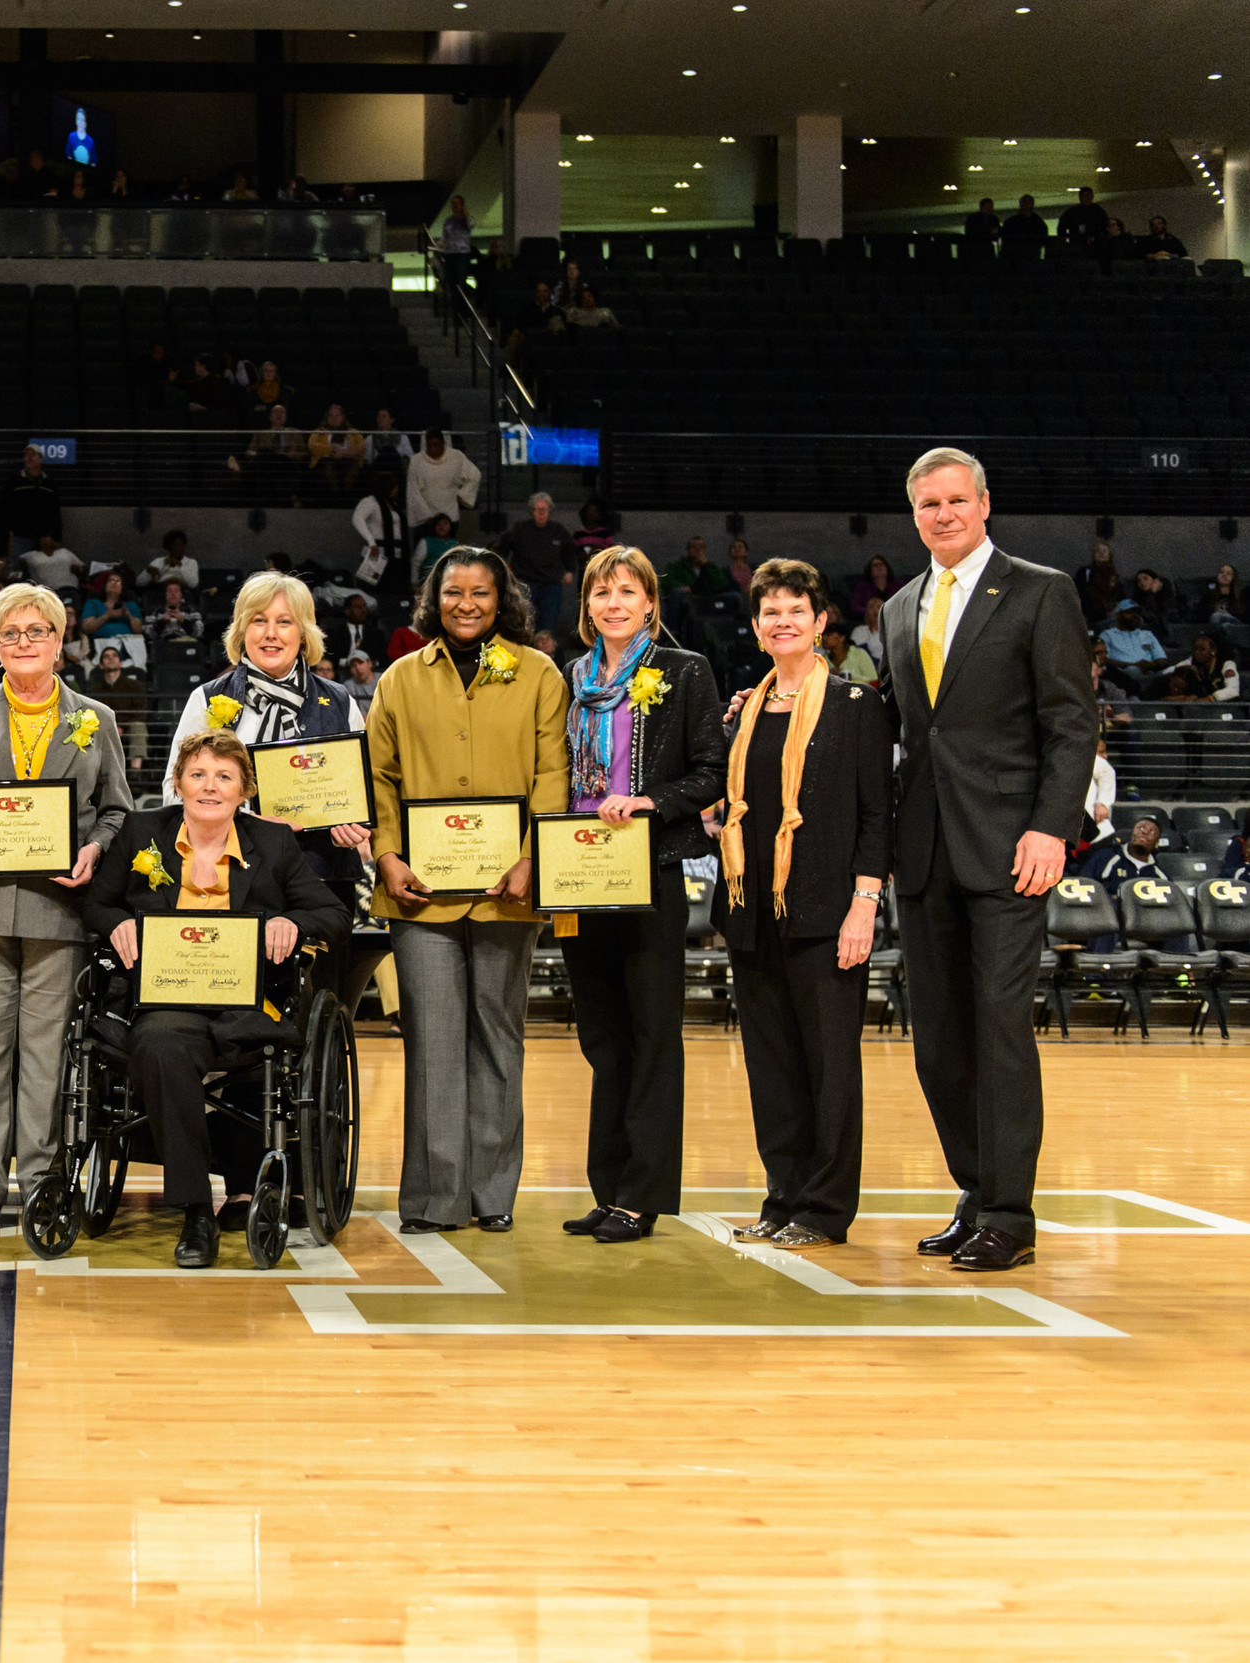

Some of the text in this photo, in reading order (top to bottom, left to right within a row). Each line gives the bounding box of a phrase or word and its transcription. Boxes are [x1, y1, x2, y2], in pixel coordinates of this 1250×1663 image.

[40, 444, 67, 459] 109
[1151, 453, 1179, 467] 110
[278, 794, 305, 803] WOMEN
[324, 790, 347, 798] FRONT
[1057, 879, 1095, 903] GT
[1133, 880, 1172, 903] GT
[1209, 881, 1247, 904] GT
